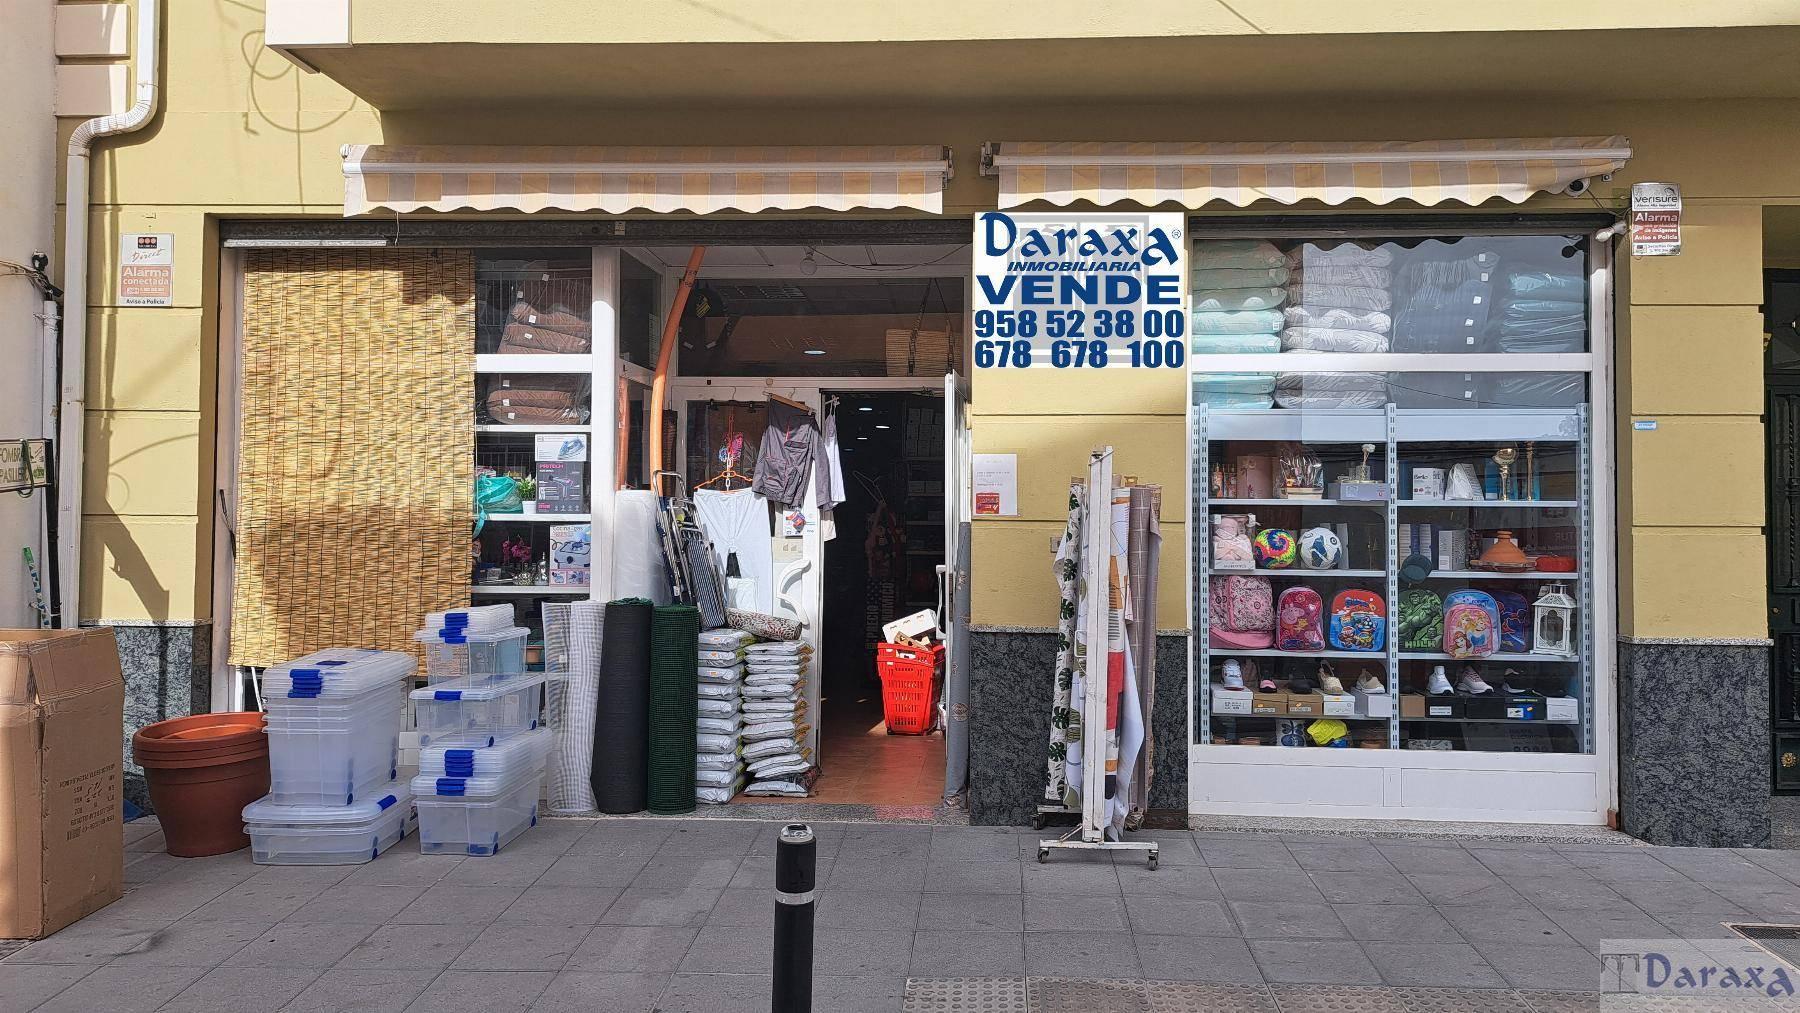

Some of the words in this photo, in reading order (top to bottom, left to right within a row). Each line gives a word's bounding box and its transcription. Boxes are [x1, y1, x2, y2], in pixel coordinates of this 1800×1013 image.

[1635, 212, 1678, 221] Alarma
[123, 266, 169, 277] Alarma
[122, 277, 169, 285] conectada
[1404, 640, 1436, 649] HULK
